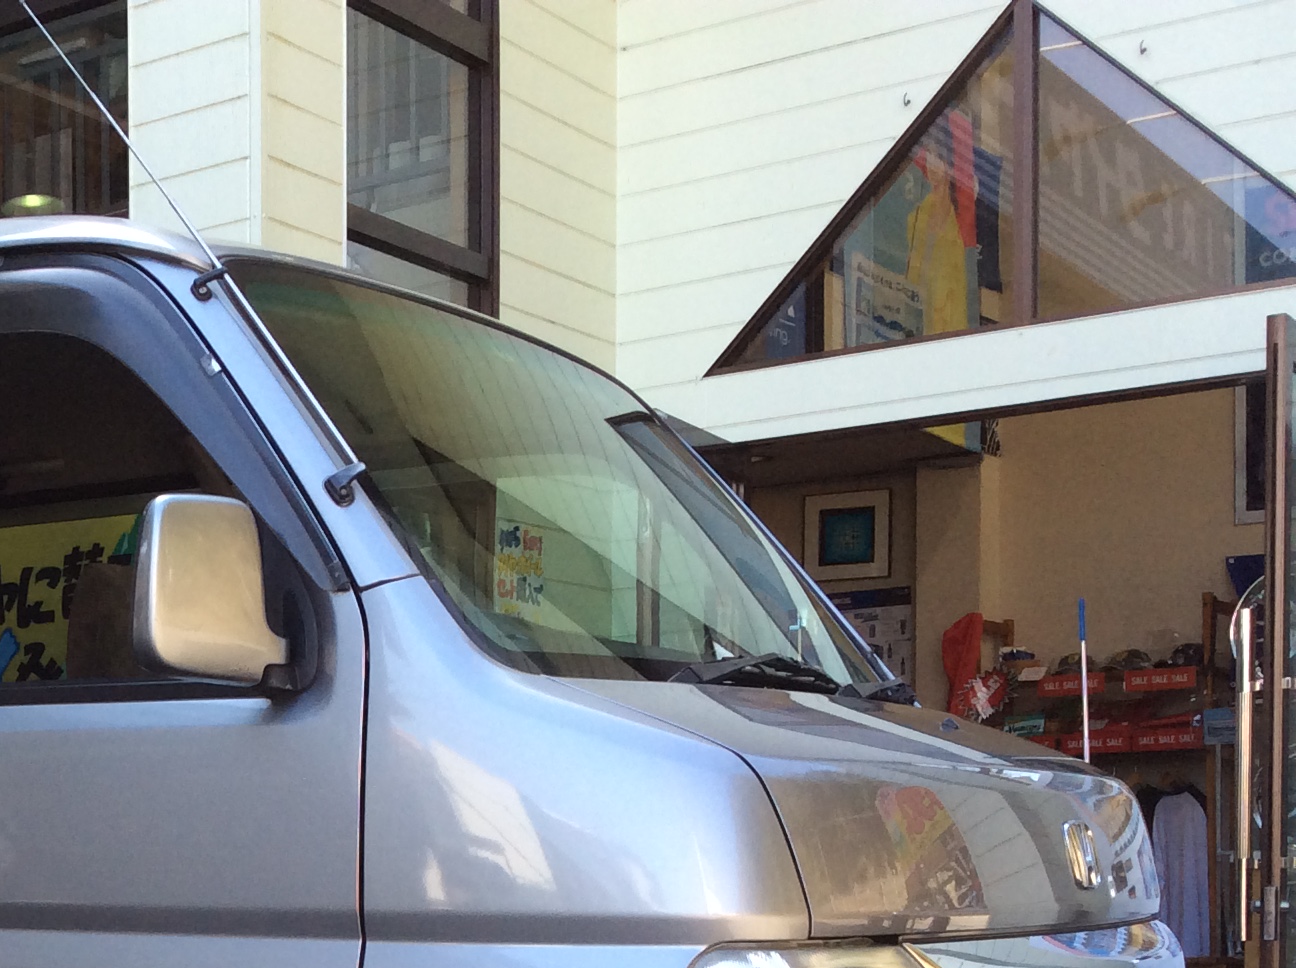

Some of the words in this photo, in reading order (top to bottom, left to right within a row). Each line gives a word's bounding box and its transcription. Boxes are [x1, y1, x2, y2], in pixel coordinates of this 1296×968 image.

[1131, 676, 1148, 685] SALE
[1151, 675, 1168, 684] SALE
[1171, 673, 1188, 683] SALE
[1106, 737, 1124, 746] SALE
[1158, 735, 1175, 744] SALE
[1179, 733, 1196, 743] SALE
